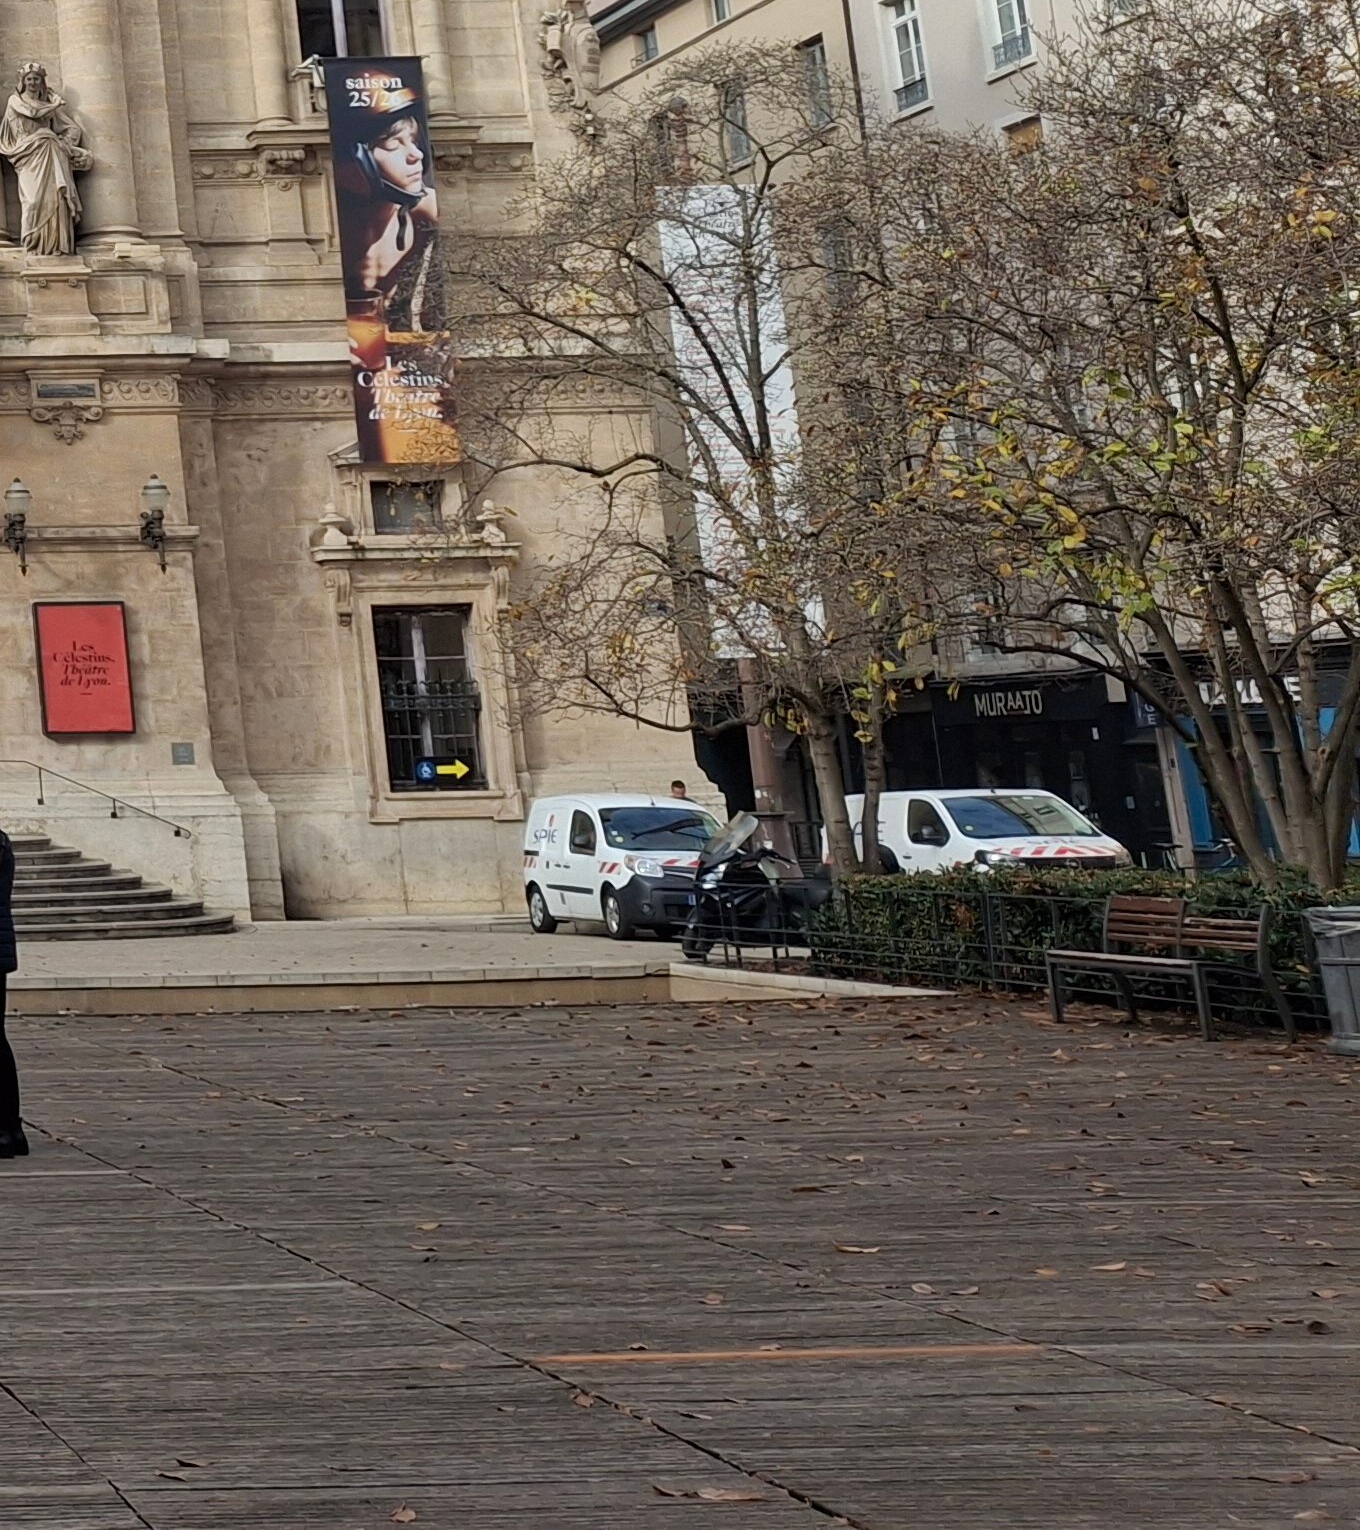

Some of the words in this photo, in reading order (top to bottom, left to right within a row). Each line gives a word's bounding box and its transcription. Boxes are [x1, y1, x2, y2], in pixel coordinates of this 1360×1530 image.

[345, 73, 403, 90] saison
[72, 641, 95, 652] Les
[52, 651, 116, 664] Célestins.
[62, 663, 110, 675] Théâtre
[60, 676, 76, 687] de
[78, 675, 112, 689] Lyon.
[533, 828, 558, 845] SPIE
